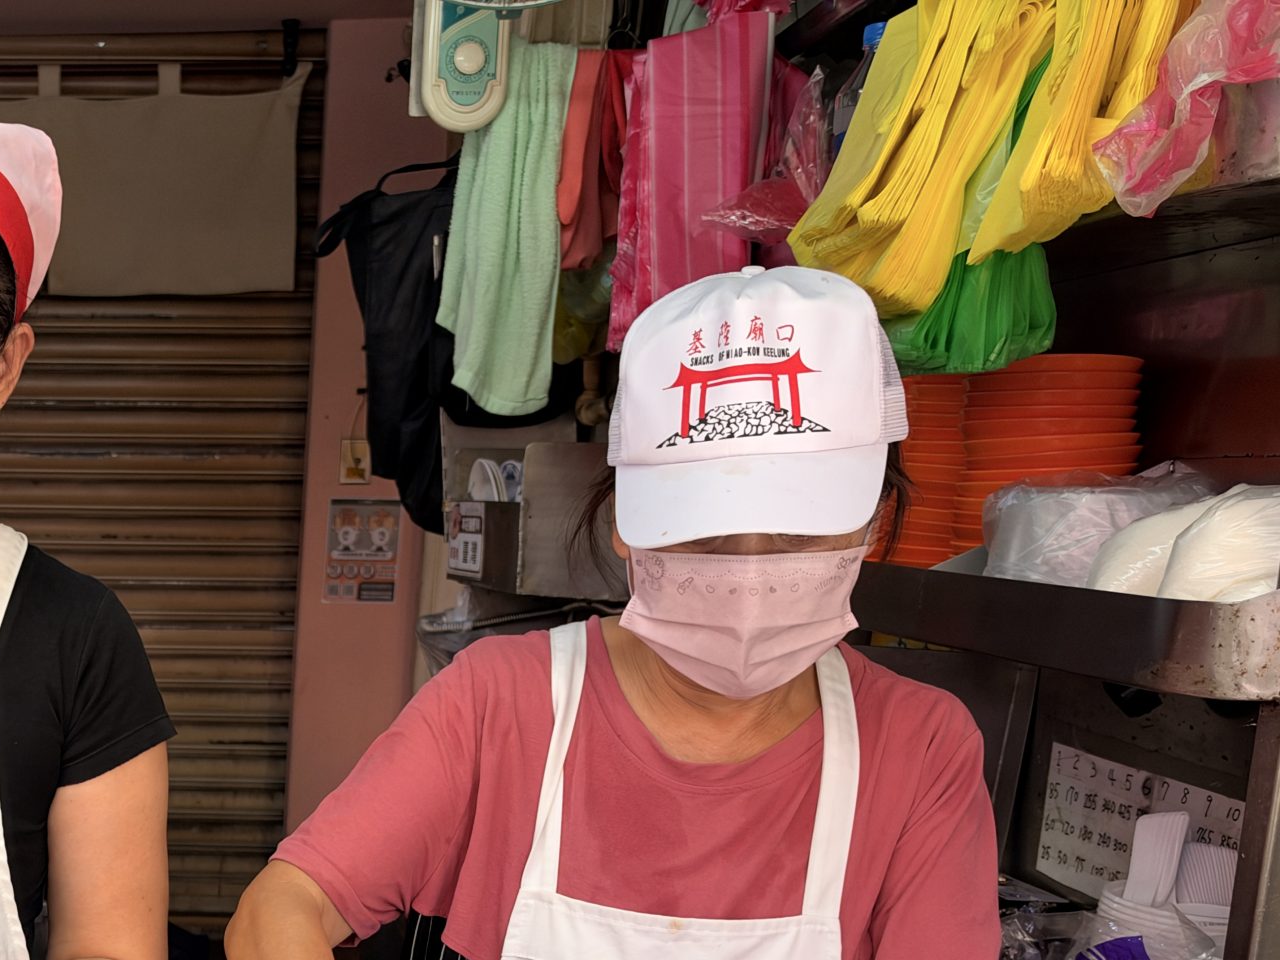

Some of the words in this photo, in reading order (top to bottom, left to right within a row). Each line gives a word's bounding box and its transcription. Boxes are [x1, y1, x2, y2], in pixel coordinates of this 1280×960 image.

[690, 354, 714, 367] SNACKS
[763, 347, 790, 358] KEELUNG
[1048, 782, 1061, 799] 85
[1196, 827, 1215, 845] 765
[1073, 754, 1080, 770] 2
[1089, 762, 1097, 778] 3
[1107, 768, 1116, 786] 4
[1124, 774, 1135, 791] 5
[1142, 777, 1152, 797] 6
[1161, 781, 1170, 801] 7
[1181, 787, 1189, 805] 8
[1204, 795, 1213, 818] 9
[1226, 807, 1241, 822] 10
